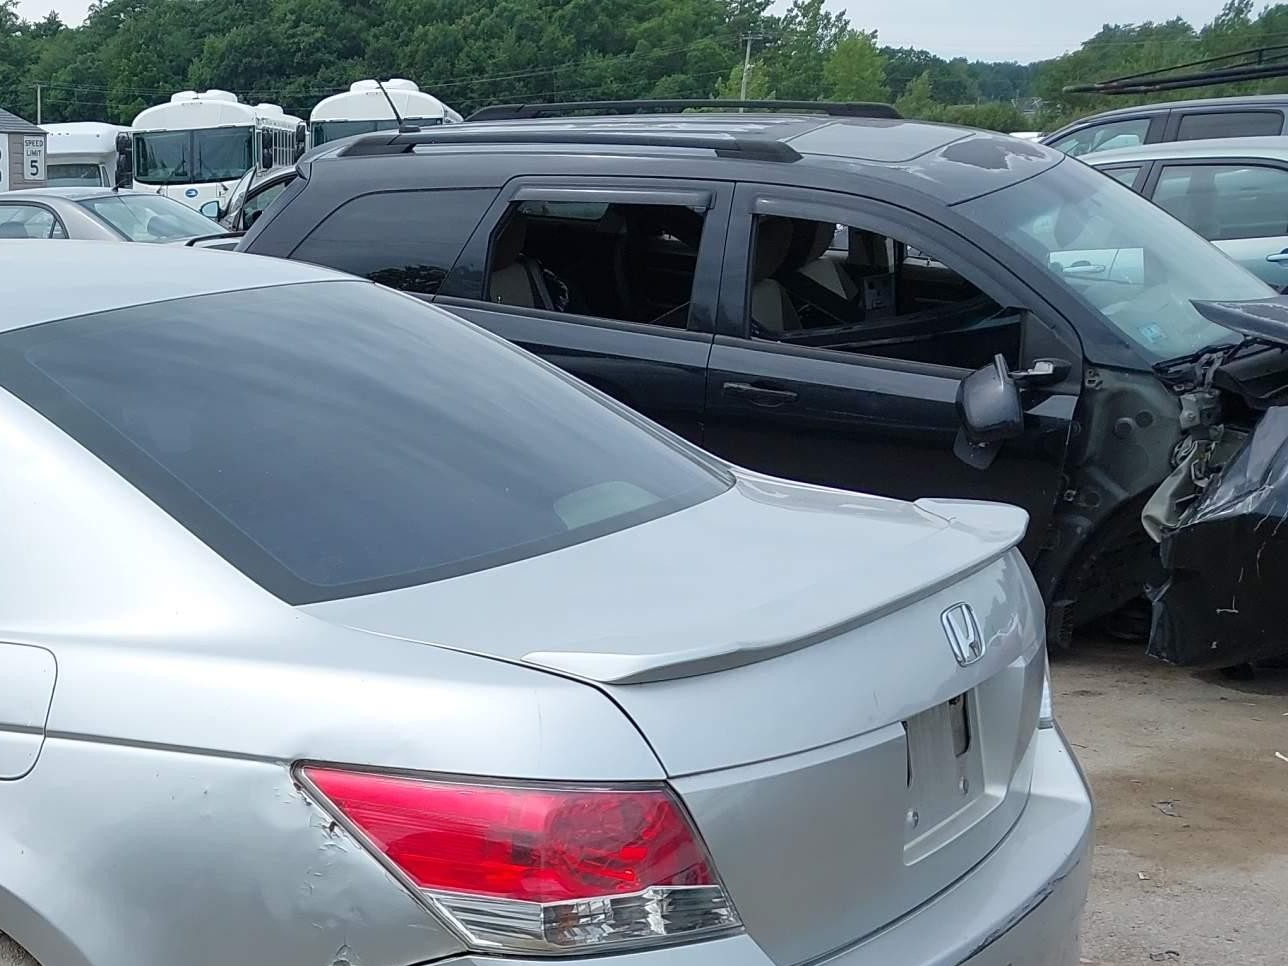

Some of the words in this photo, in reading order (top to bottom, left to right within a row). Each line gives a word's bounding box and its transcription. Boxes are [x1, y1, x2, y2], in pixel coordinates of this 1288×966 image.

[25, 139, 43, 147] SPEED
[26, 149, 41, 157] LIMIT
[30, 160, 39, 176] 5
